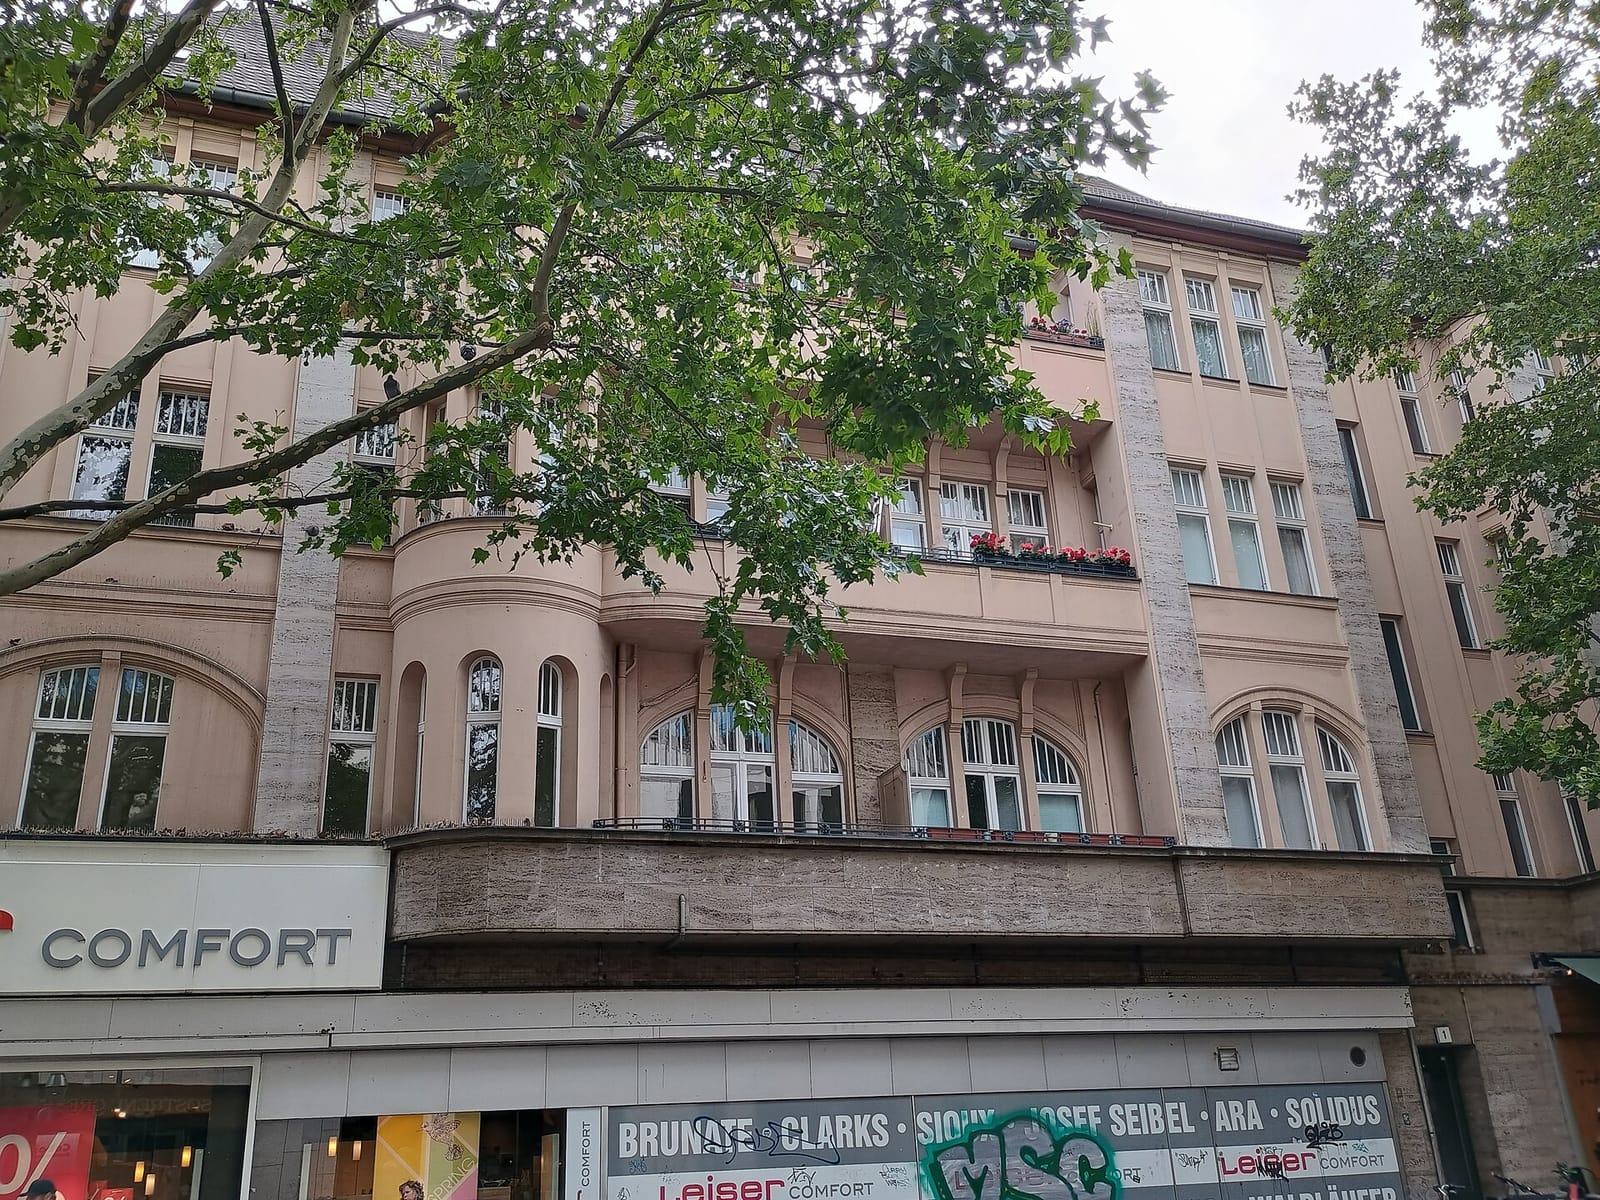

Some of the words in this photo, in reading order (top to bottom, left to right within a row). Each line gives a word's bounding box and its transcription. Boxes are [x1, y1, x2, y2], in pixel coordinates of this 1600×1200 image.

[41, 927, 353, 968] COMFORT
[779, 1113, 890, 1150] CLARKS
[1108, 1101, 1196, 1137] SEIBEL
[1214, 1099, 1265, 1132] ARA
[1285, 1094, 1382, 1129] SOLIDUS
[580, 1121, 592, 1187] COMFORT
[1221, 1148, 1317, 1175] Leiser
[1319, 1154, 1385, 1170] COMFORT
[788, 1181, 875, 1199] COMFORT
